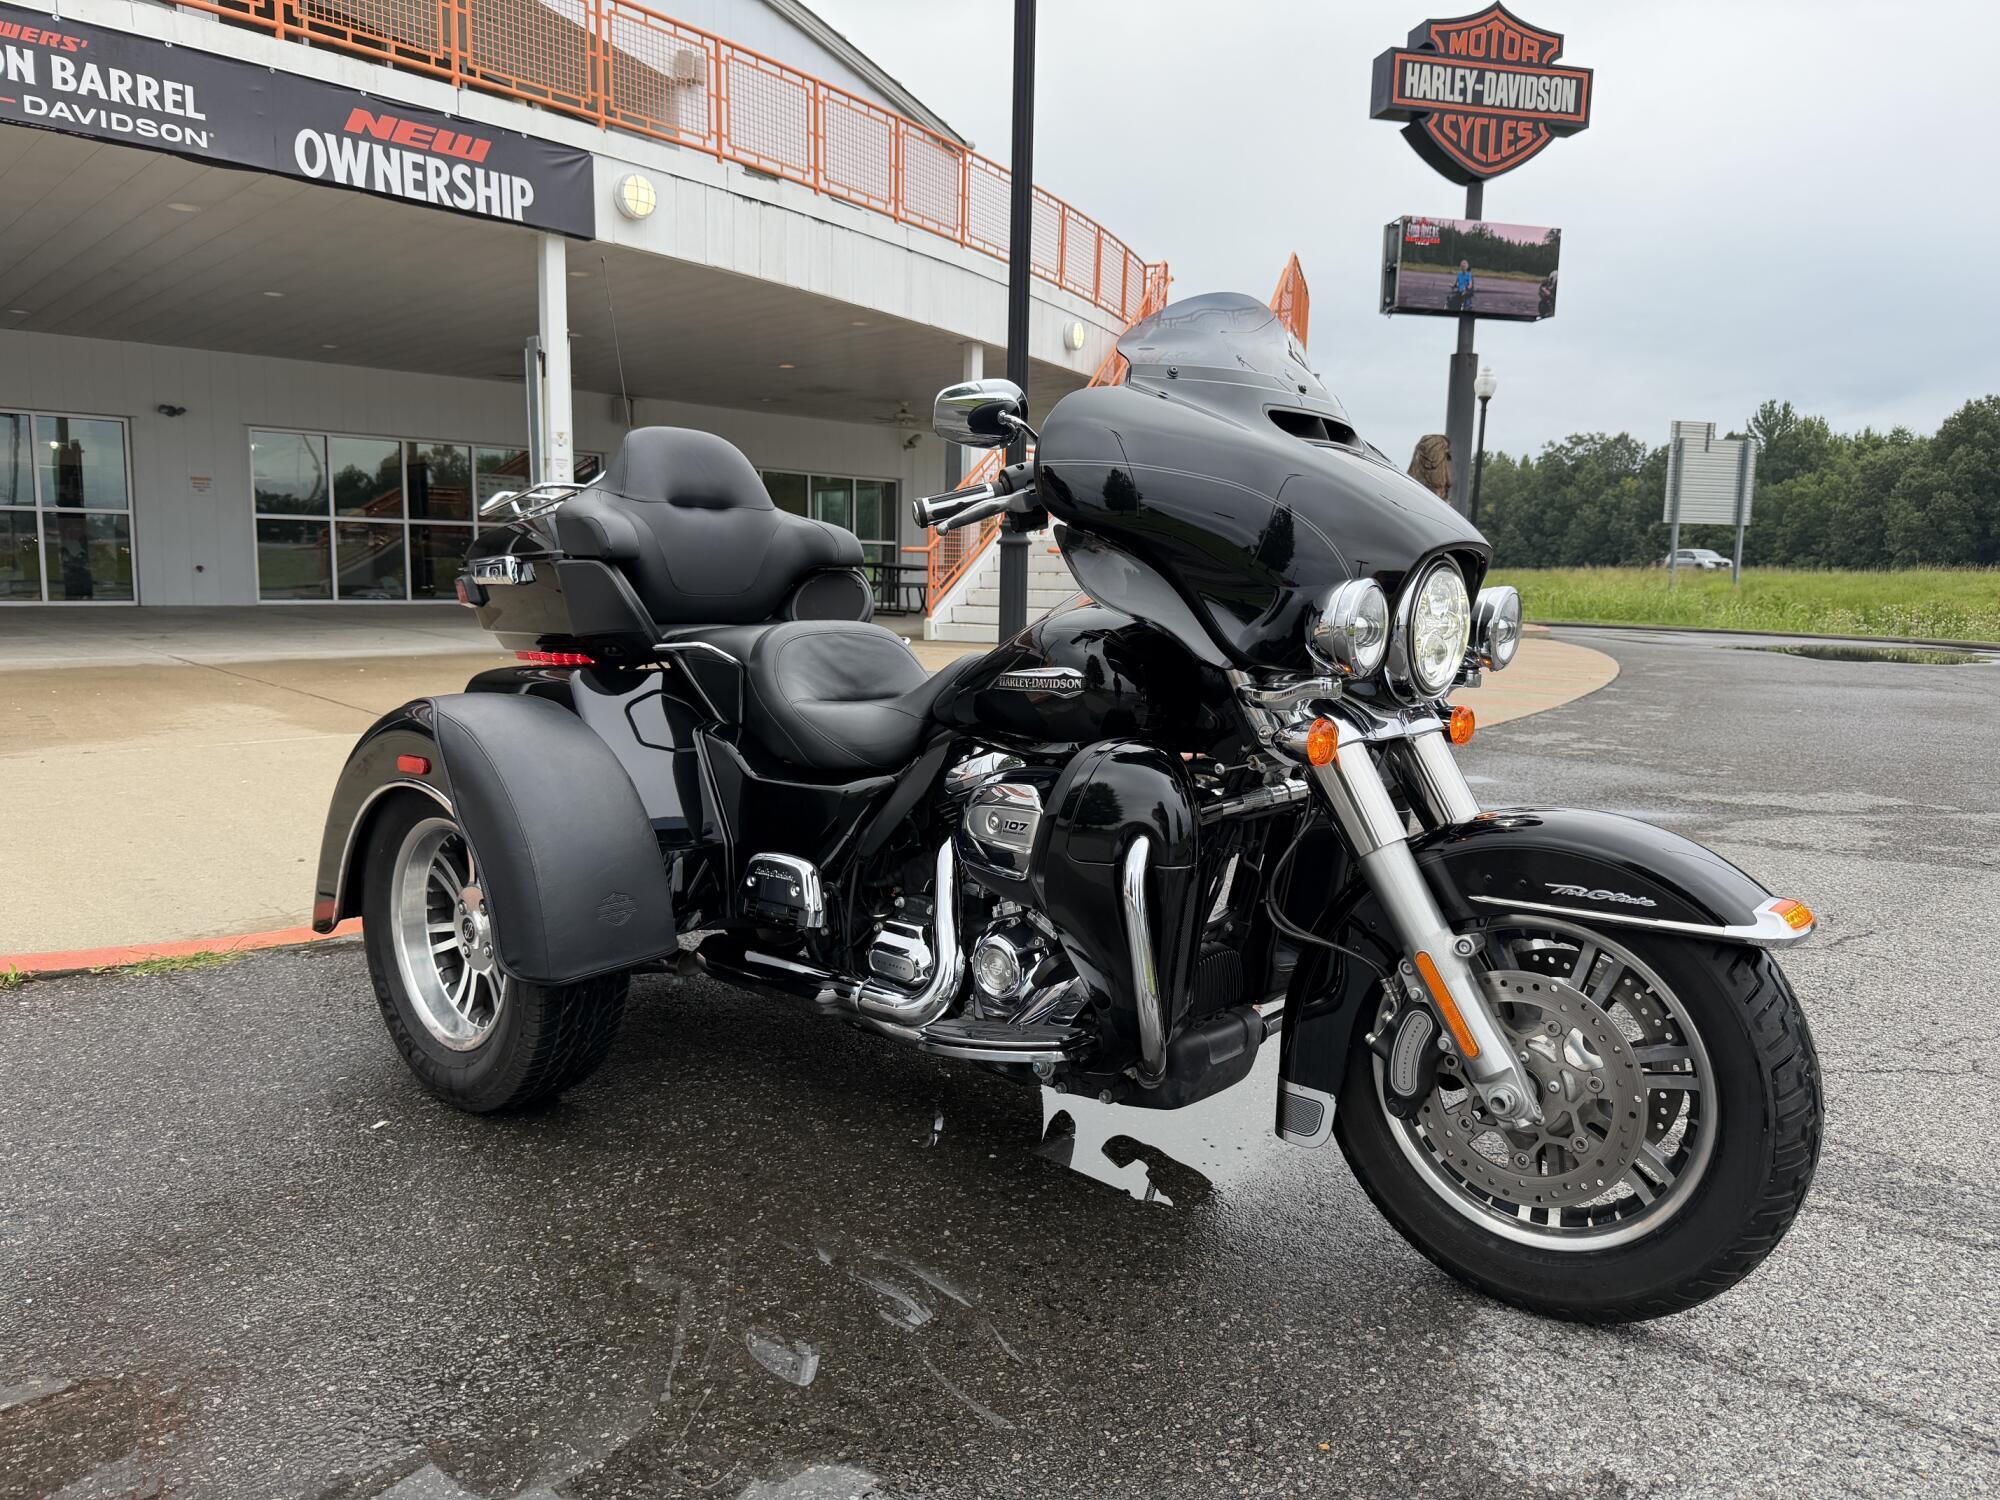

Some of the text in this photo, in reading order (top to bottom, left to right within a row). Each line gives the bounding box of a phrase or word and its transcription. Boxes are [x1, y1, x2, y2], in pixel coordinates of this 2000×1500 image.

[1449, 19, 1540, 64] MOTOR
[0, 45, 206, 121] N BARREL
[1405, 62, 1577, 113] HARLEY-DAVIDSON
[23, 94, 209, 149] DAVIDSON
[343, 107, 492, 163] NEW
[1443, 114, 1534, 163] CYCLES
[294, 128, 534, 222] OWNERSHIP
[999, 677, 1082, 689] HARLEY-DAVIDSON
[1004, 820, 1029, 831] 107
